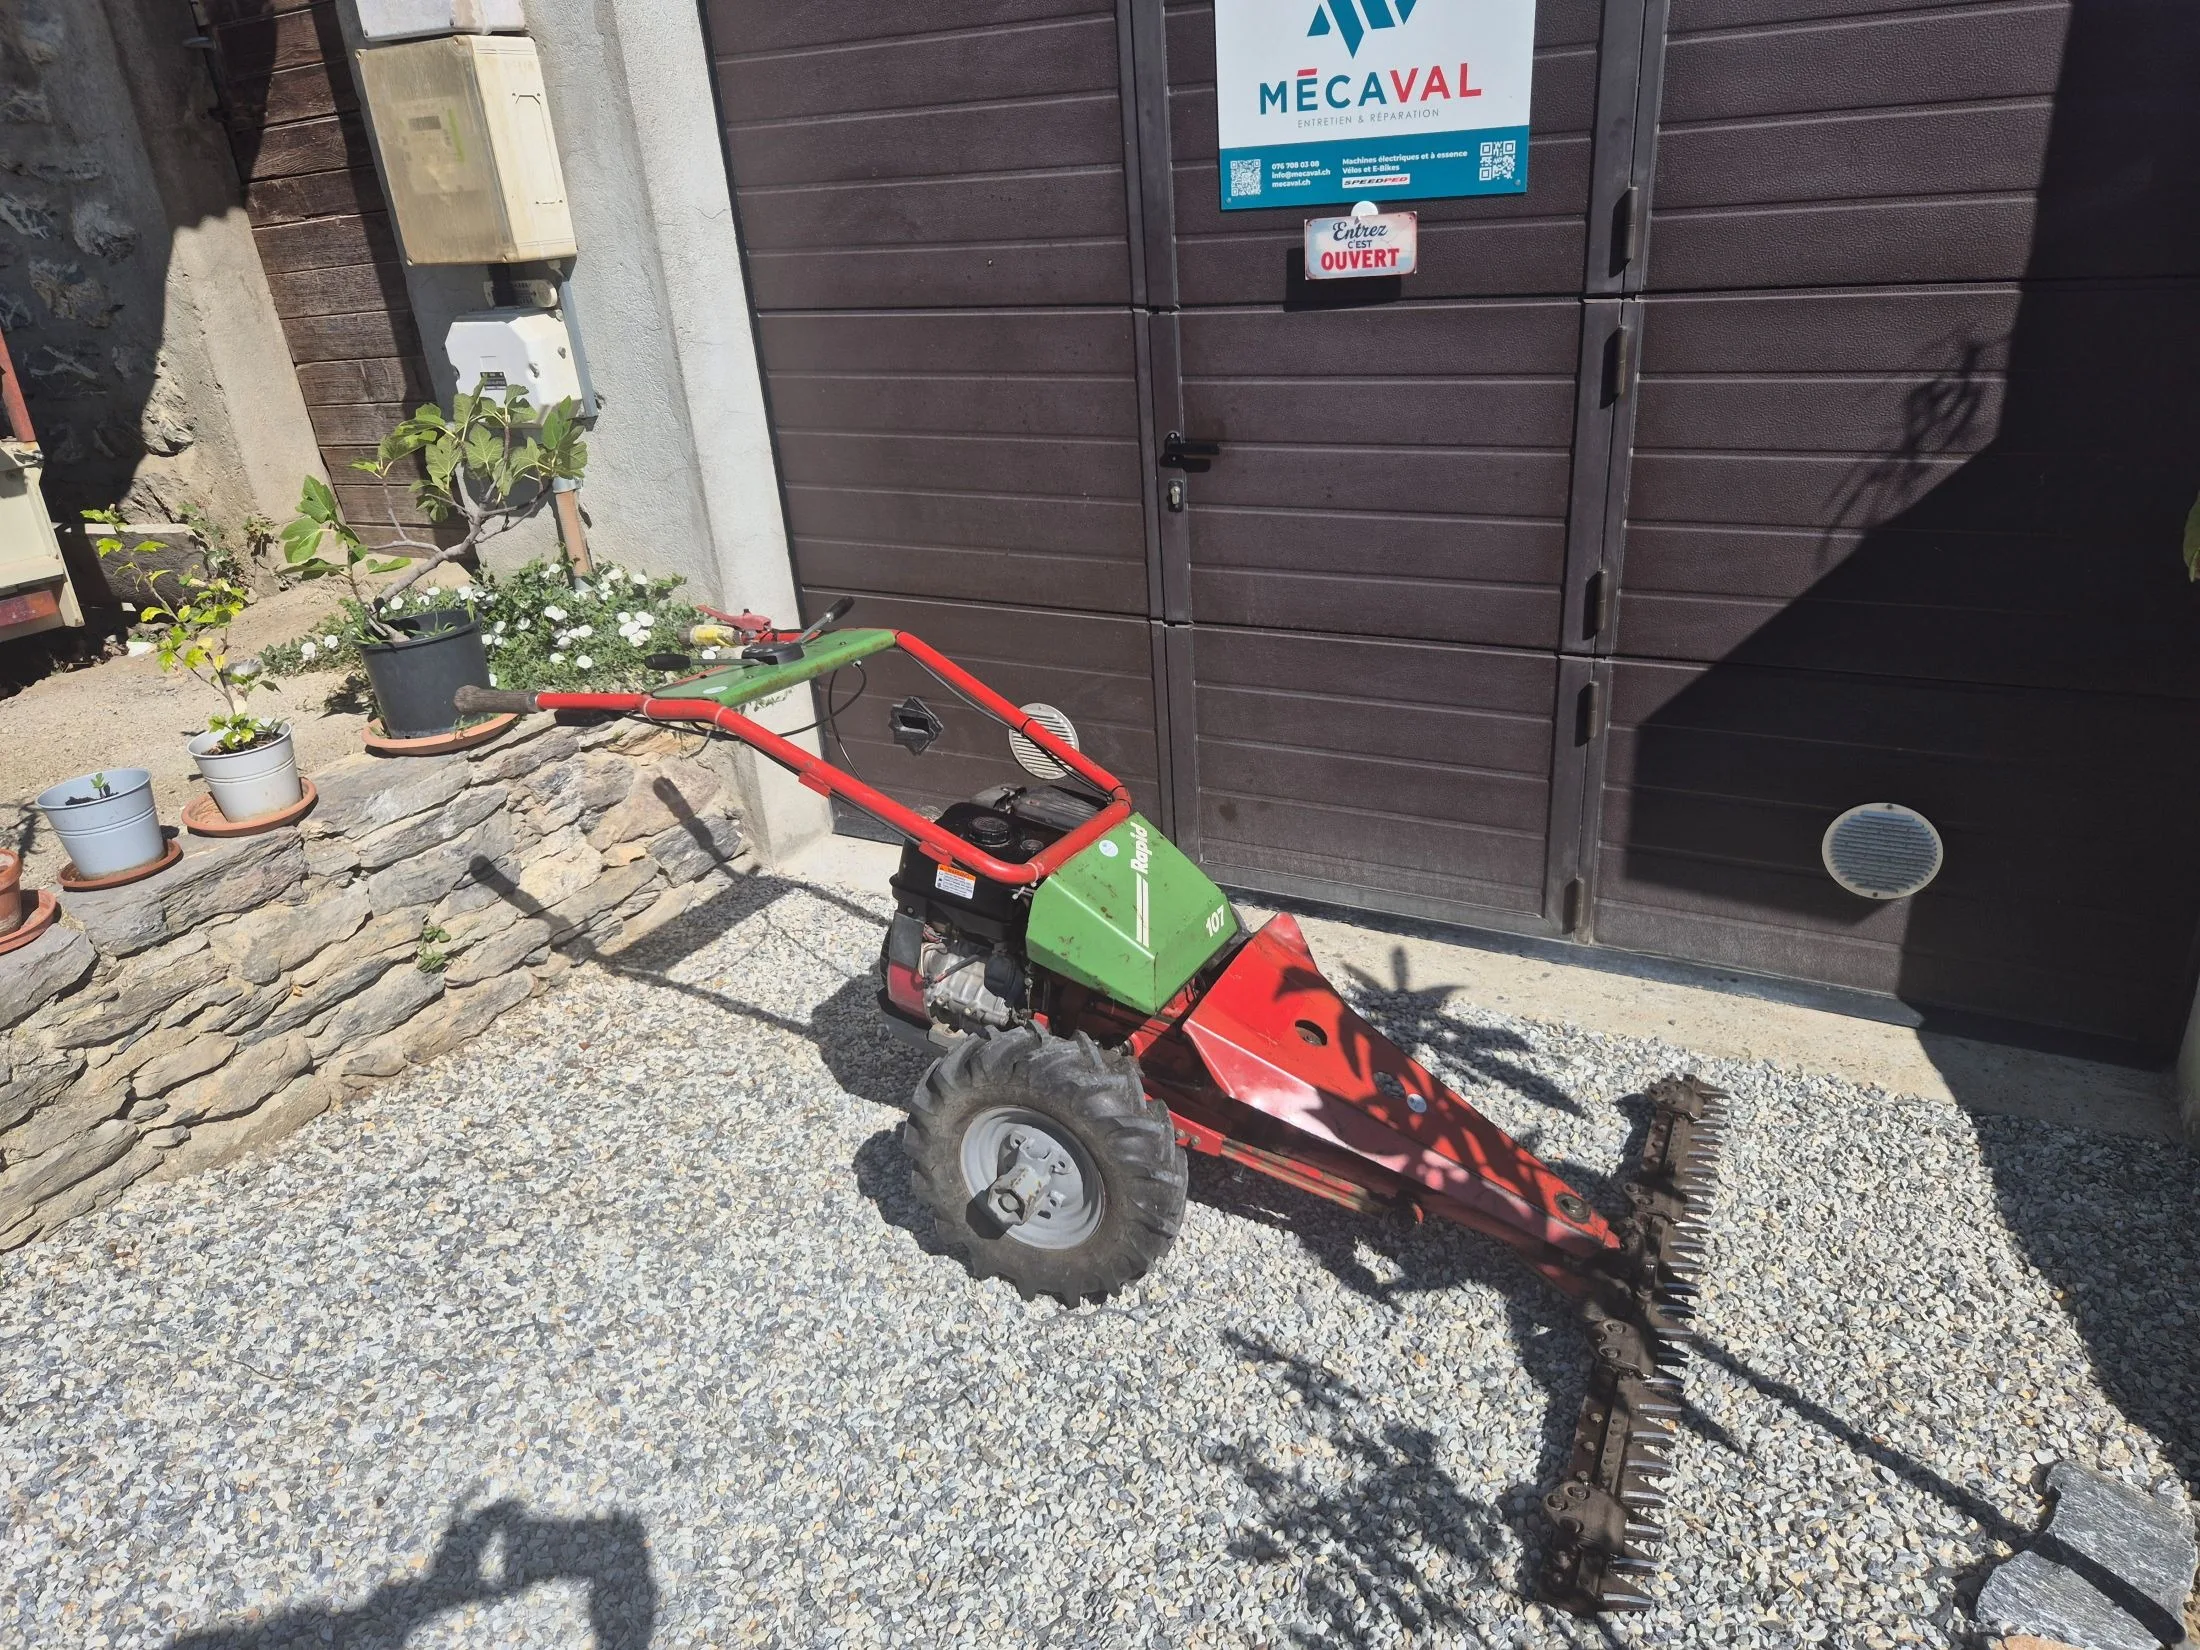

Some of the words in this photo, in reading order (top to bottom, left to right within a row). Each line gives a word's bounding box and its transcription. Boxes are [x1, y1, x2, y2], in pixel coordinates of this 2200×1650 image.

[1259, 62, 1482, 115] MÉCAVAL
[1297, 115, 1352, 128] ENTRETIEN
[1358, 116, 1365, 124] &
[1369, 108, 1440, 123] RÉPARATION
[1342, 156, 1377, 165] Machines
[1378, 153, 1419, 163] électriques
[1430, 151, 1435, 159] à
[1436, 151, 1468, 159] essence
[1271, 168, 1331, 179] info@mecaval.ch
[1342, 166, 1362, 175] Vélos
[1372, 164, 1400, 173] E-Bikes
[1271, 179, 1311, 188] mecaval.ch
[1343, 176, 1408, 186] SPEEDPED
[1332, 221, 1389, 241] Entrez
[1347, 240, 1373, 249] C'EST
[1320, 247, 1400, 271] OUVERT
[1129, 821, 1153, 875] Rapid
[1205, 904, 1225, 938] 107
